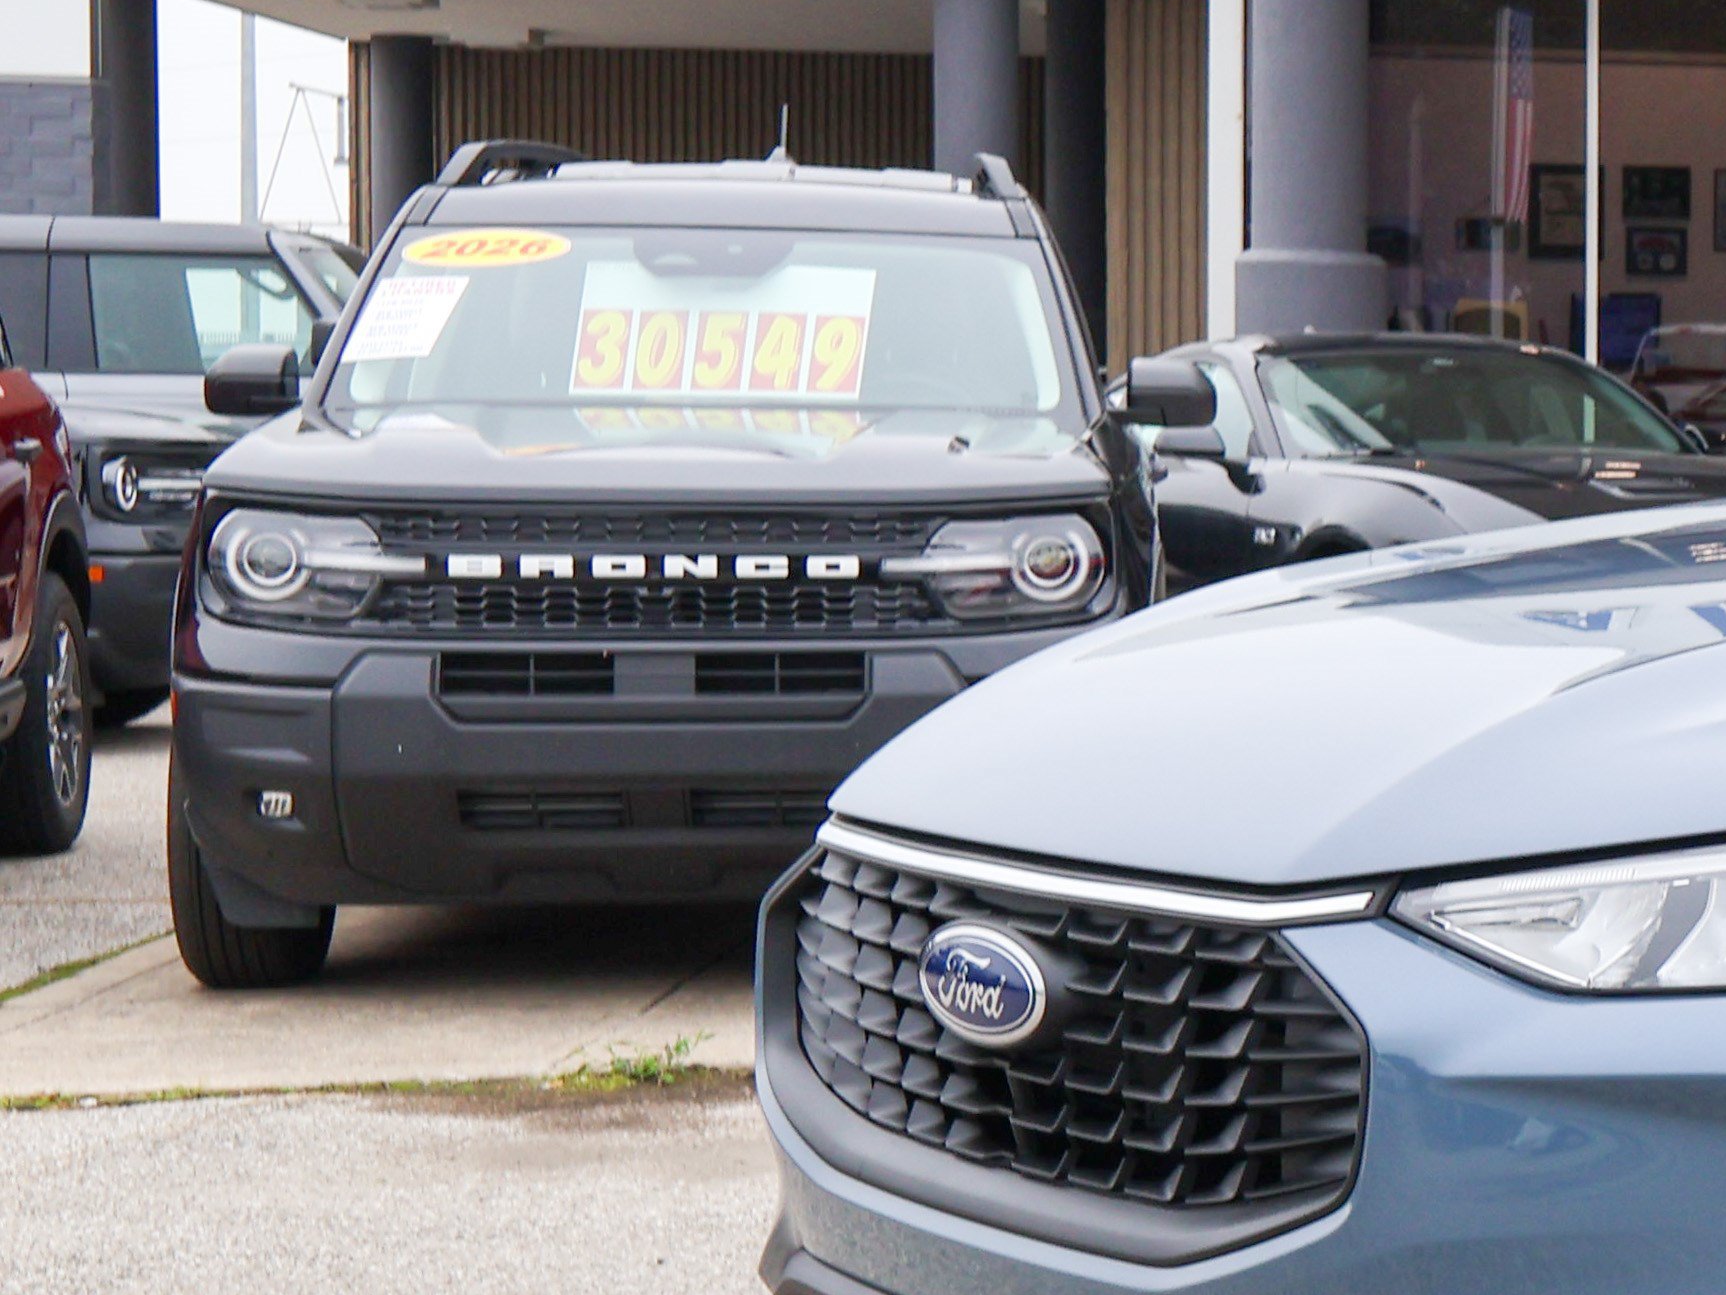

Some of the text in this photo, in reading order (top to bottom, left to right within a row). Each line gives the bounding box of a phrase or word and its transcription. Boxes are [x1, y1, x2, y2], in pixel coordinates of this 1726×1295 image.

[426, 234, 549, 260] 2026
[577, 310, 866, 391] 30549
[446, 553, 860, 579] BRONCO
[938, 947, 1006, 1020] Ford
